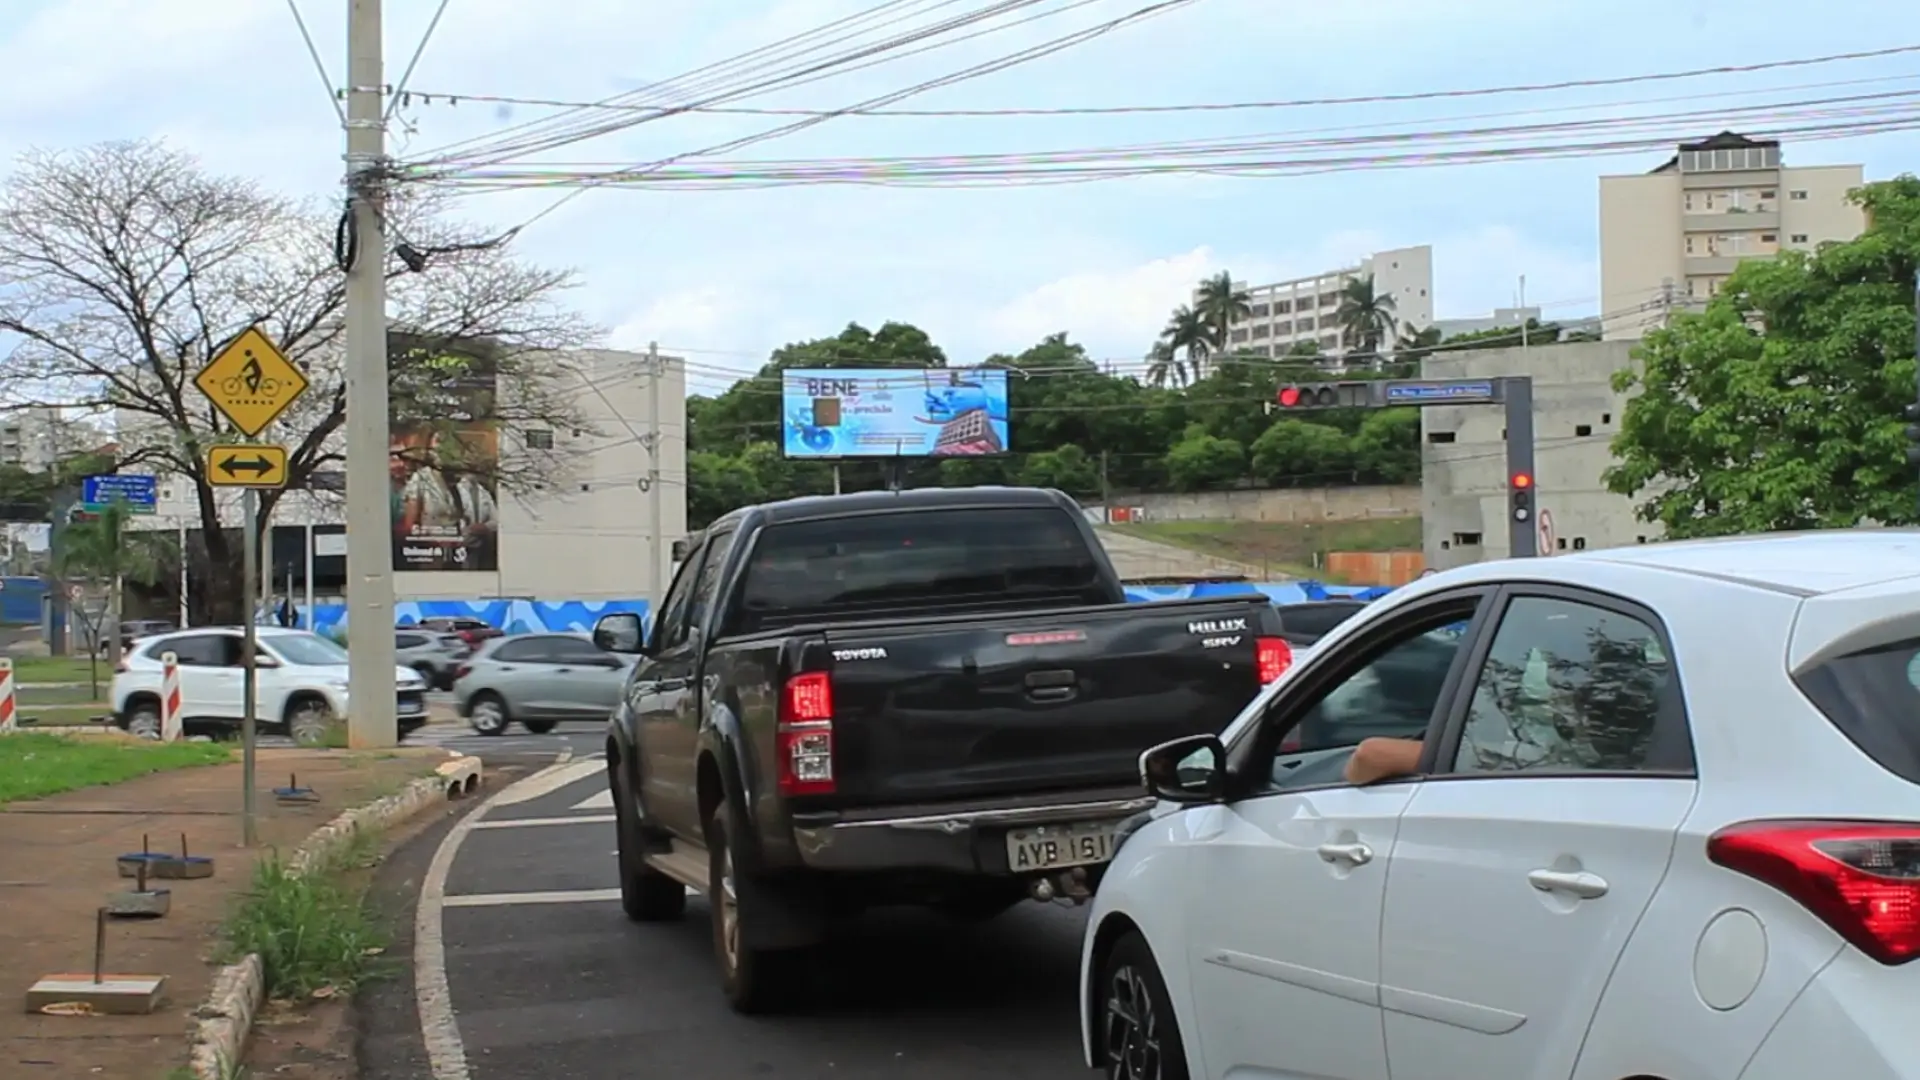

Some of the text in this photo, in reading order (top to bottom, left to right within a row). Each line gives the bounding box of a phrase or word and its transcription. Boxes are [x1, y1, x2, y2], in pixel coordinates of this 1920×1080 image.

[808, 378, 859, 396] BENE
[1188, 618, 1248, 633] HILUX
[1202, 635, 1241, 648] SRV
[832, 648, 887, 661] TOYOTA
